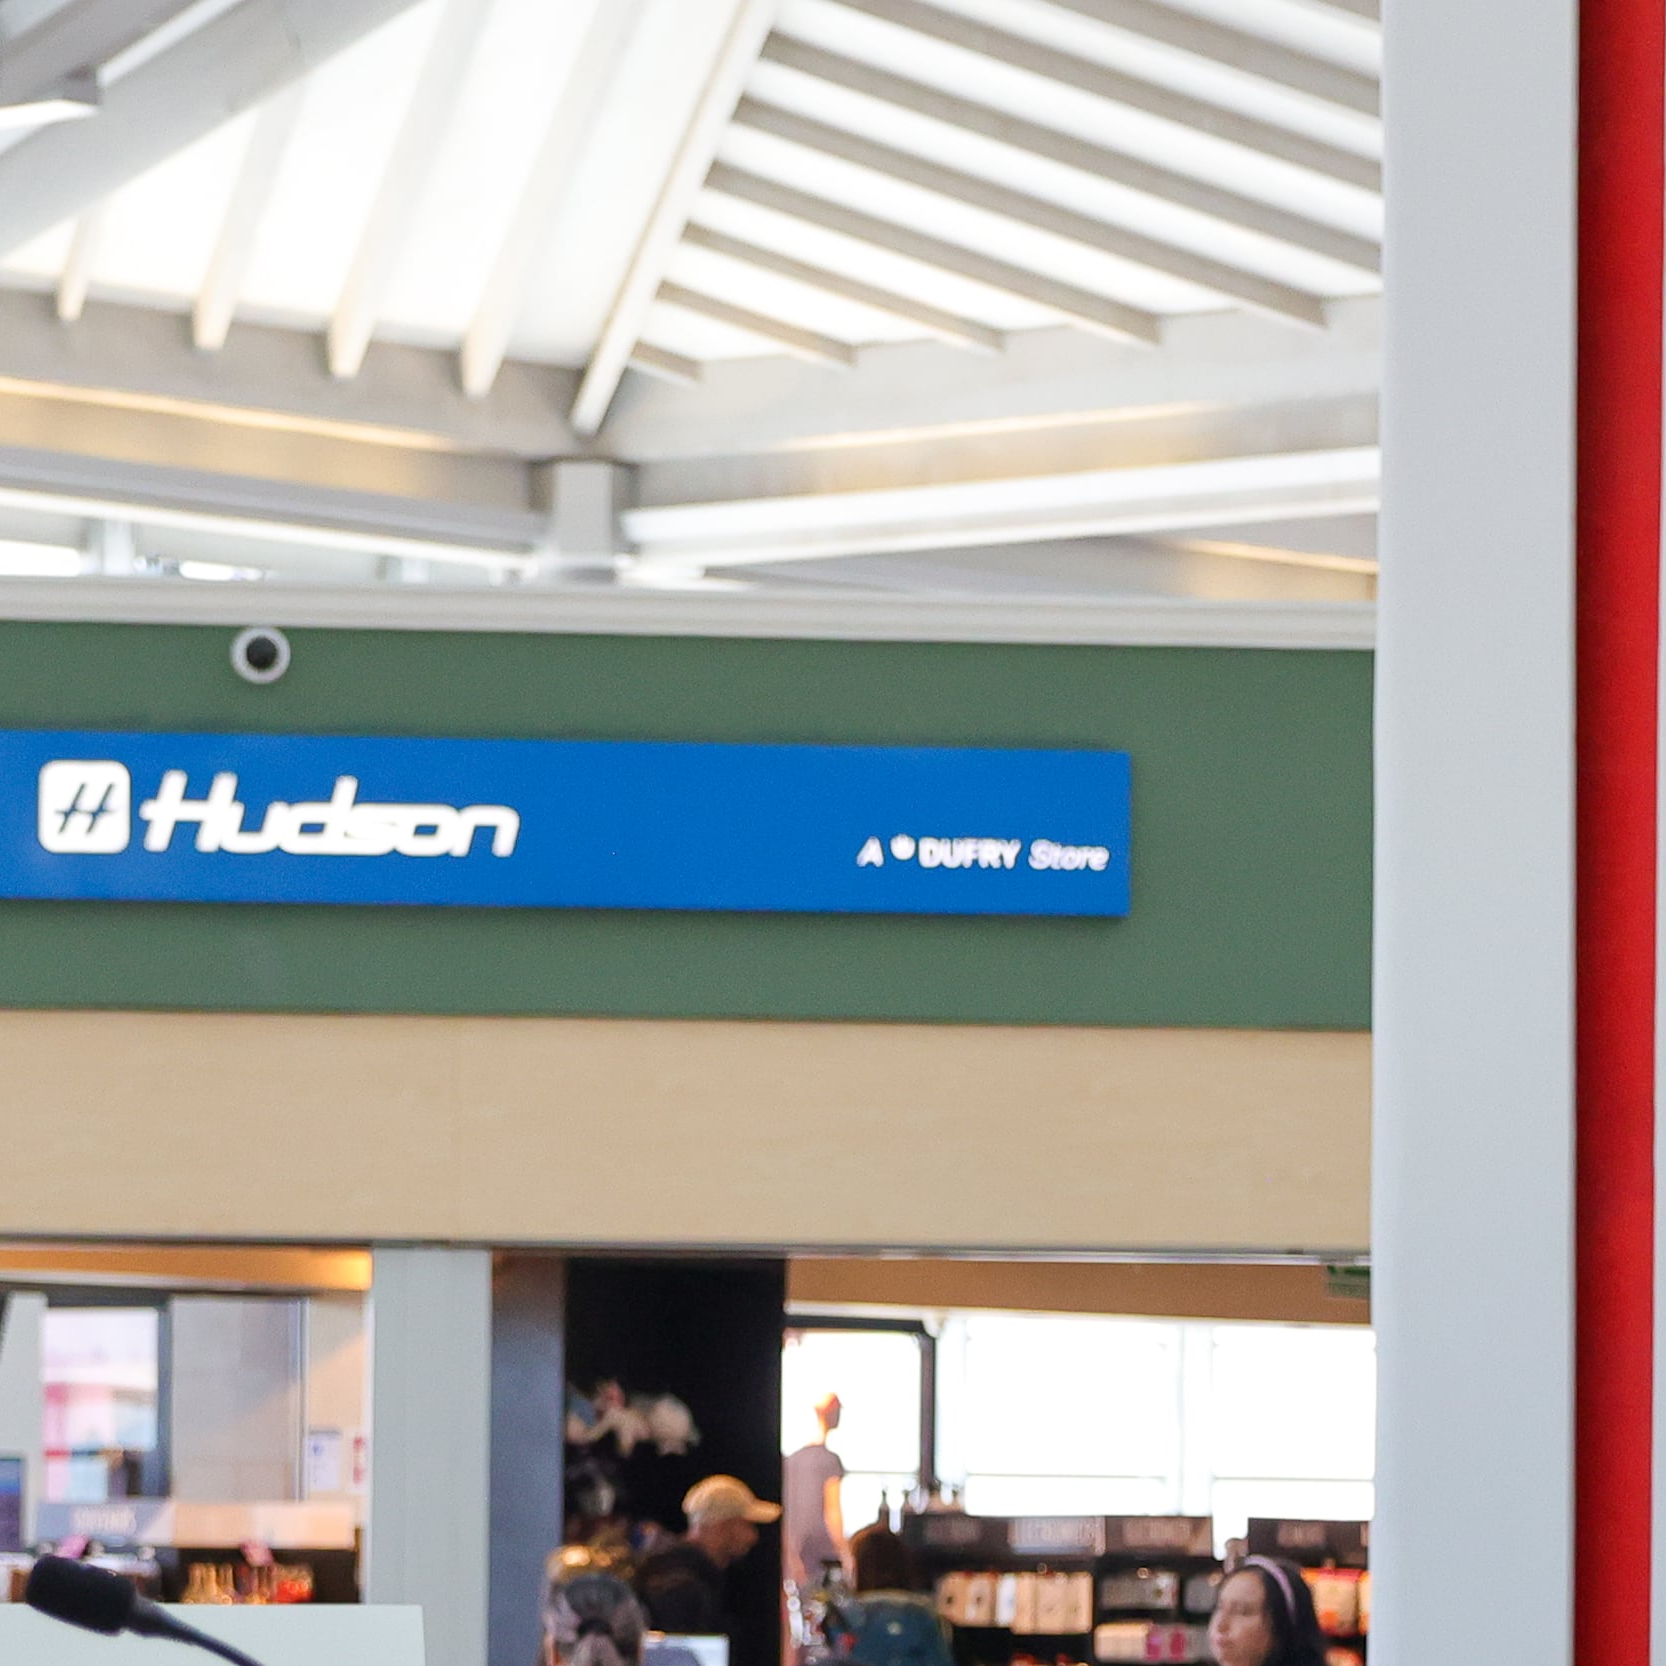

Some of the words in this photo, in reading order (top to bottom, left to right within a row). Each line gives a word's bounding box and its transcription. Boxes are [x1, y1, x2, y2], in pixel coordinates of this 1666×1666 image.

[139, 769, 521, 858] Hudson
[856, 836, 884, 867] A
[918, 836, 1021, 869] DUFRY
[1028, 839, 1110, 871] Store
